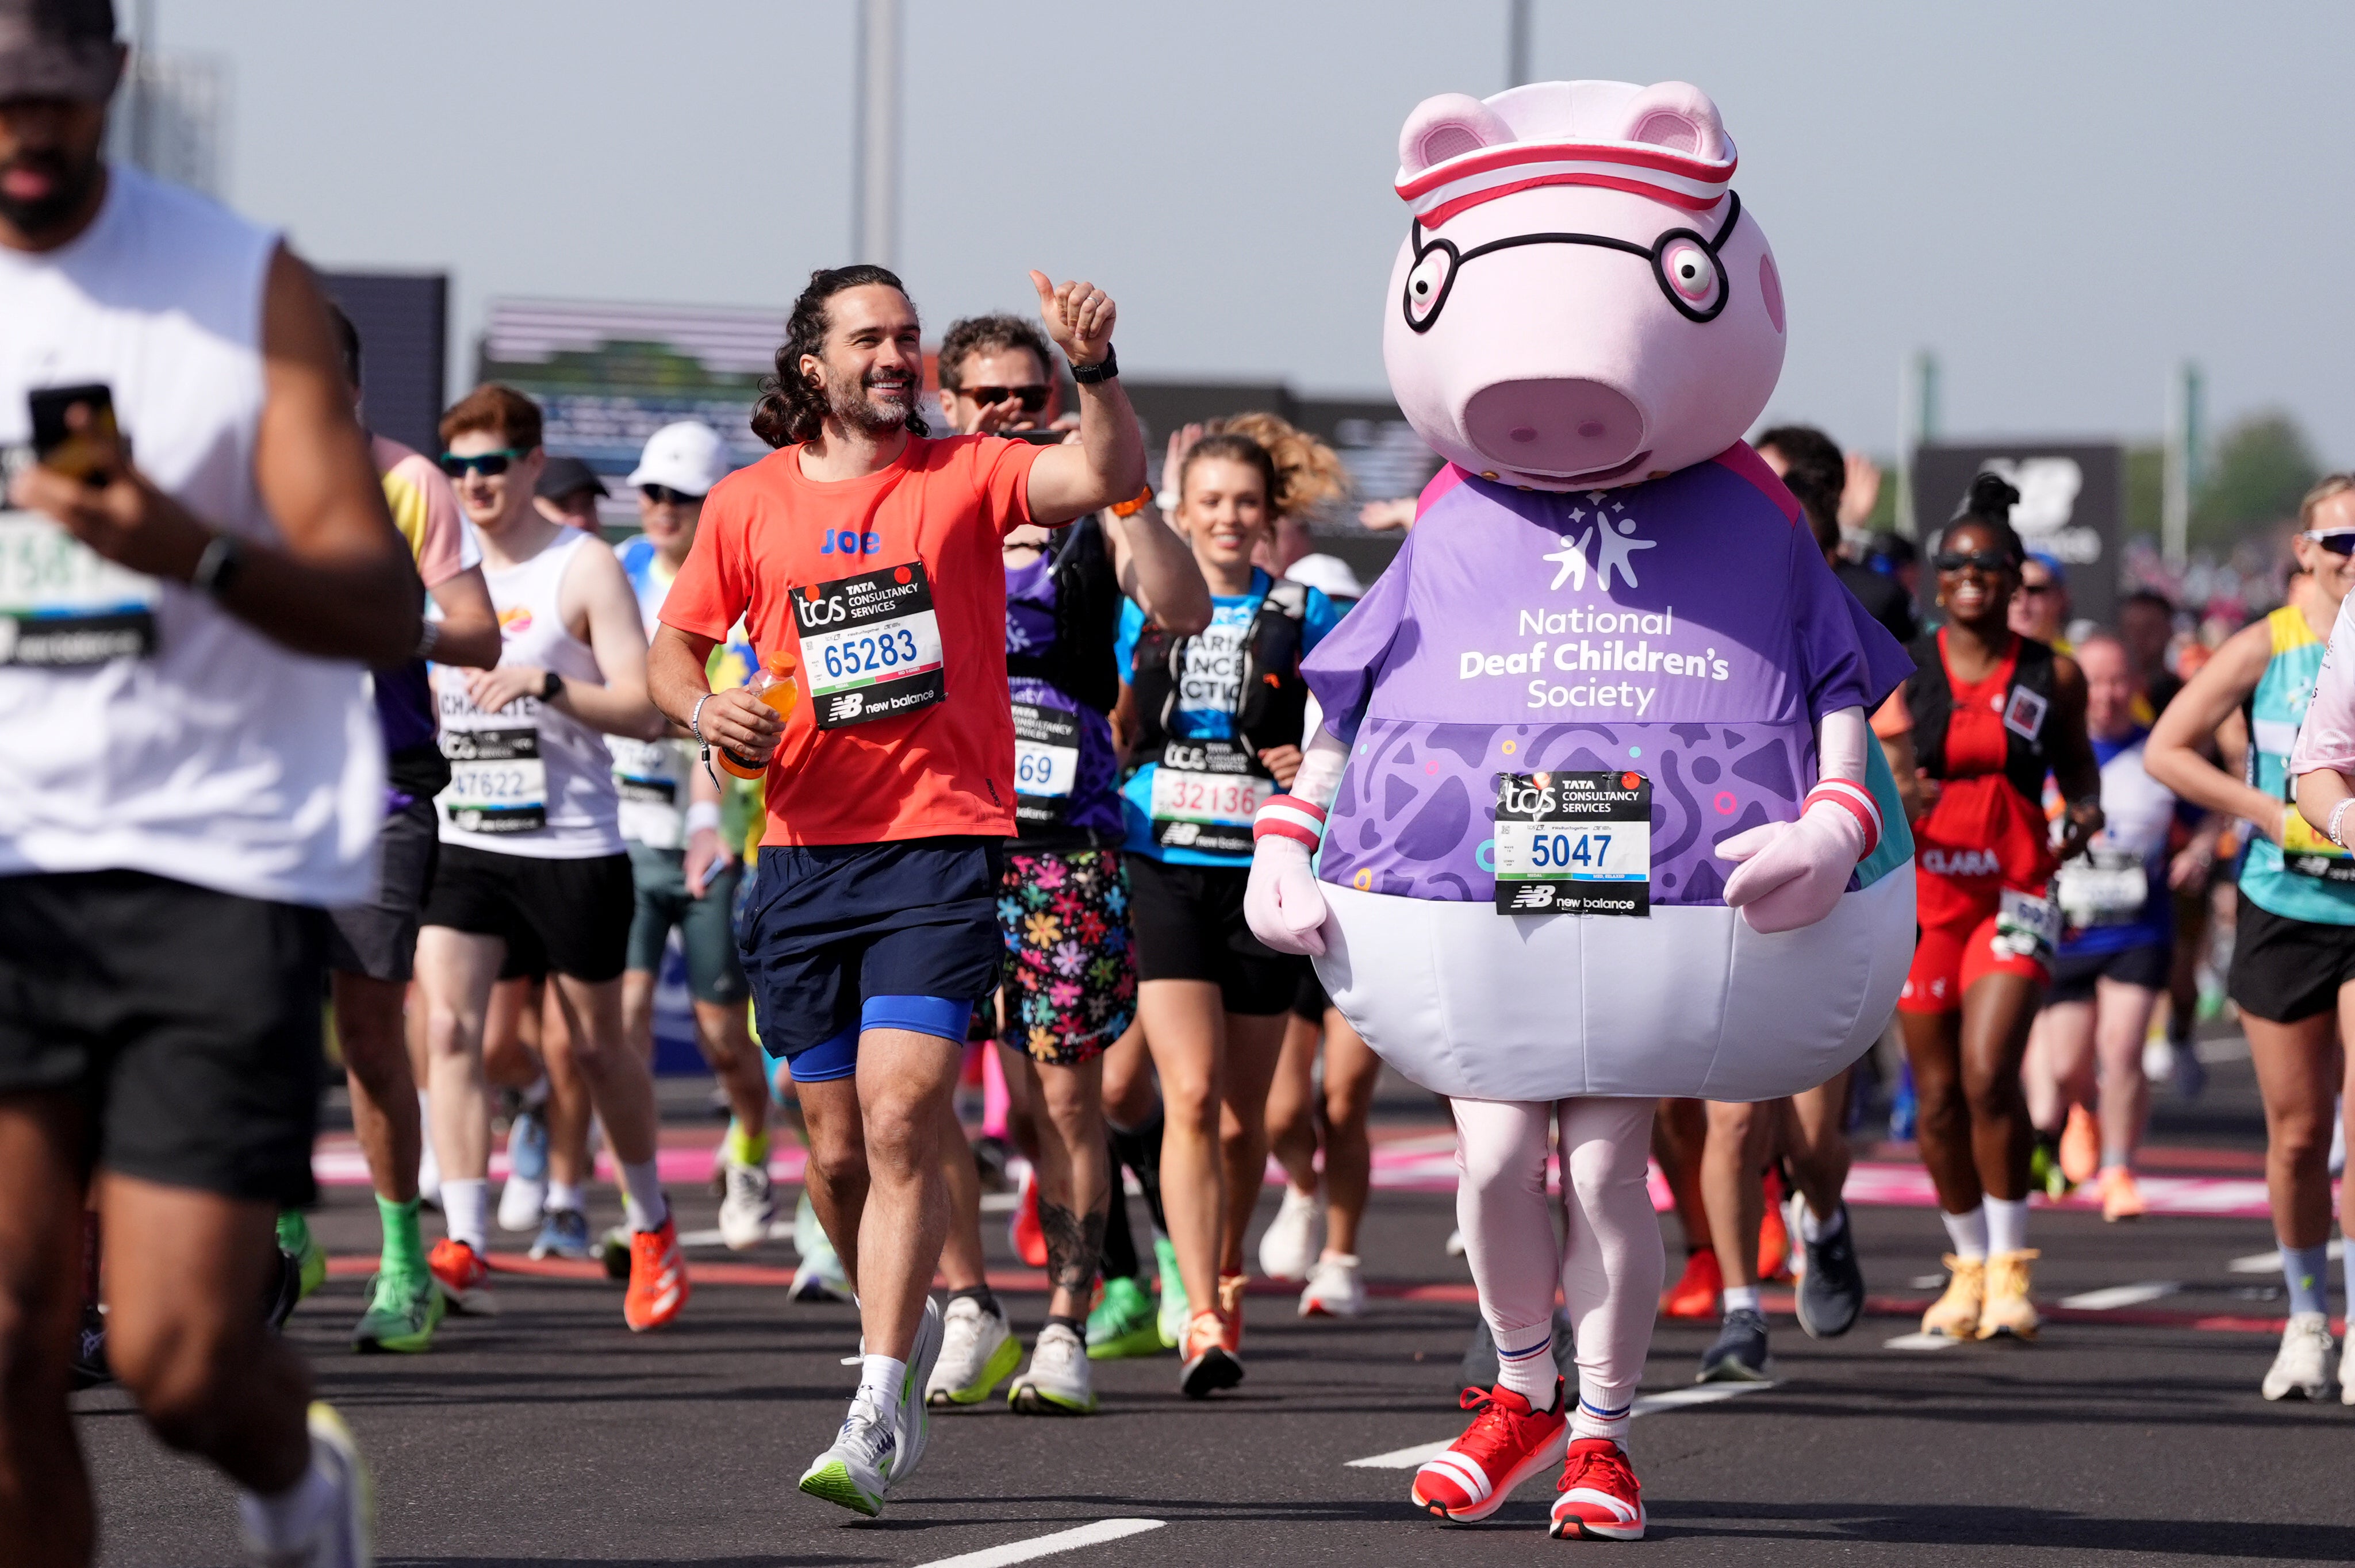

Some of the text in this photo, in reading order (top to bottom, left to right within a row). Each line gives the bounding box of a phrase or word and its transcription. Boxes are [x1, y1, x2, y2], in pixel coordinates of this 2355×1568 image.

[820, 528, 881, 555] Joe
[846, 581, 877, 595] TATA
[848, 583, 919, 607] CONSULTANCY
[799, 594, 846, 628] tcs
[850, 600, 896, 619] SERVICES
[1519, 604, 1673, 636] National
[824, 629, 917, 678] 65283
[1459, 640, 1729, 681] Deaf Children's
[865, 700, 889, 714] new
[891, 689, 935, 711] balance
[1527, 677, 1656, 716] Society
[1171, 781, 1256, 815] 32136
[1505, 781, 1556, 814] tcs
[1562, 780, 1595, 790] TATA
[1562, 791, 1639, 801] CONSULTANCY
[1562, 803, 1611, 813] SERVICES
[1531, 834, 1612, 867] 5047
[1923, 848, 2000, 877] CLARA
[1556, 897, 1581, 908] new
[1583, 897, 1635, 910] balance
